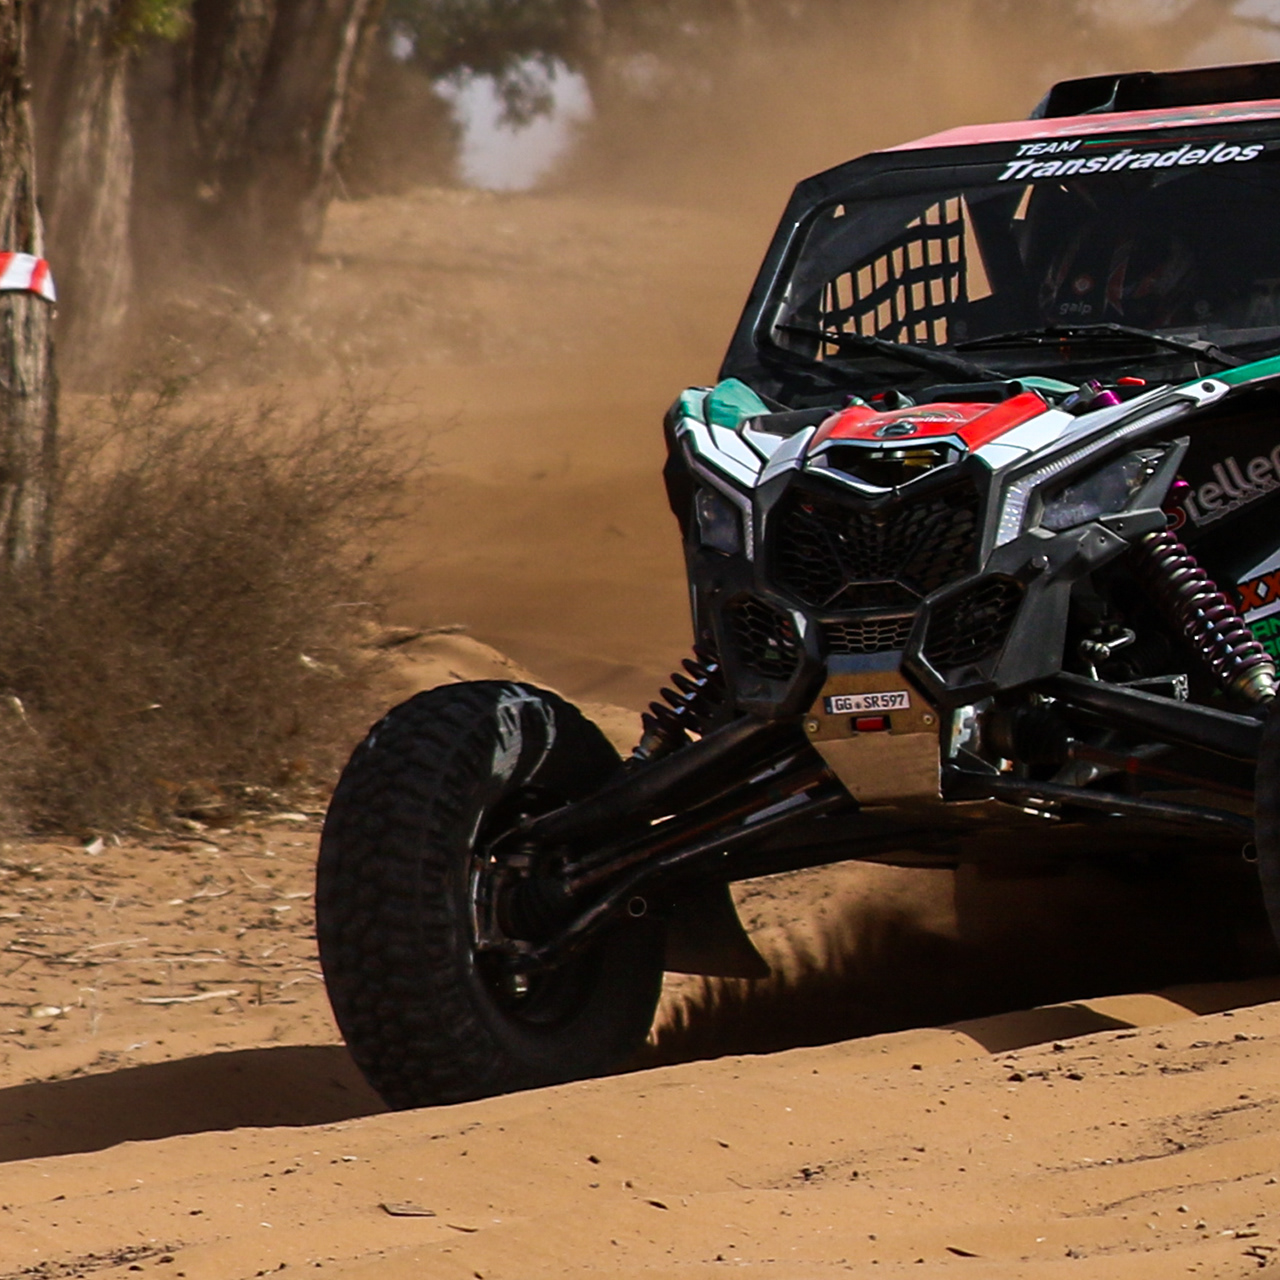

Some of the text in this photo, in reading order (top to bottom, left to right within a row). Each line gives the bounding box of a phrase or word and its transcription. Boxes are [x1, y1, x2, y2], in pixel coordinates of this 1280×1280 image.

[1016, 139, 1082, 156] TEAM
[997, 142, 1264, 181] Transfradelos
[835, 698, 853, 711] GG
